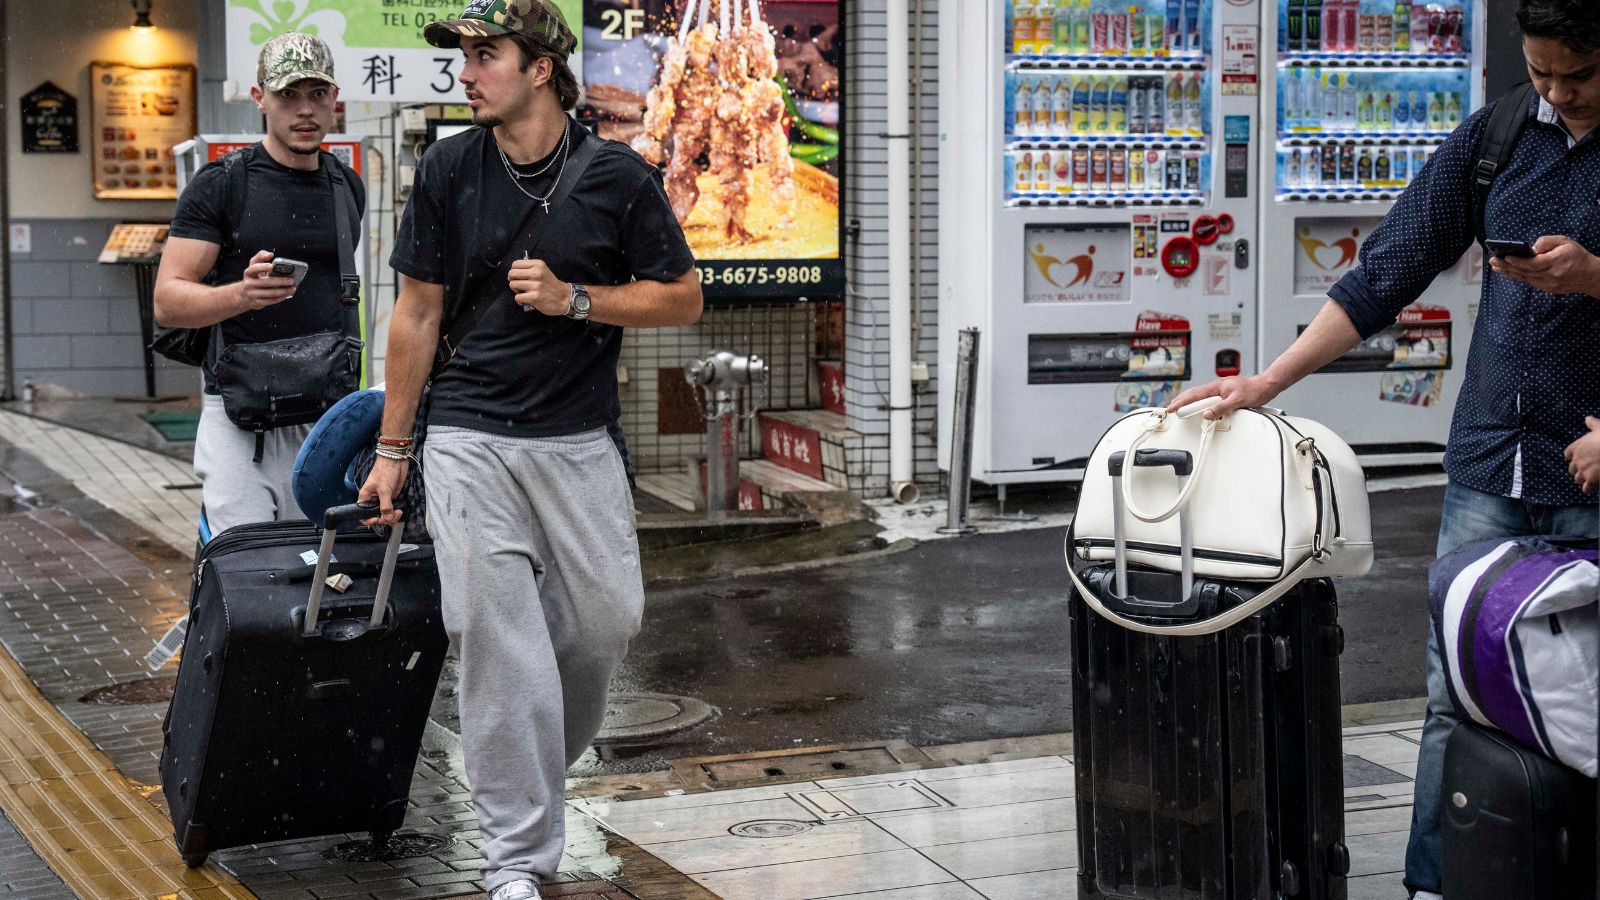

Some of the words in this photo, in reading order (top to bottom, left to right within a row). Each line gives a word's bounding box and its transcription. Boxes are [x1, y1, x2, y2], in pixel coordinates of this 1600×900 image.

[382, 13, 409, 27] TEL
[601, 9, 645, 40] 2F
[291, 38, 314, 62] NY
[362, 54, 402, 95] 科
[431, 57, 455, 93] 3
[695, 266, 821, 285] 03-6675-9808
[1138, 320, 1161, 330] Have
[1401, 310, 1423, 321] Have
